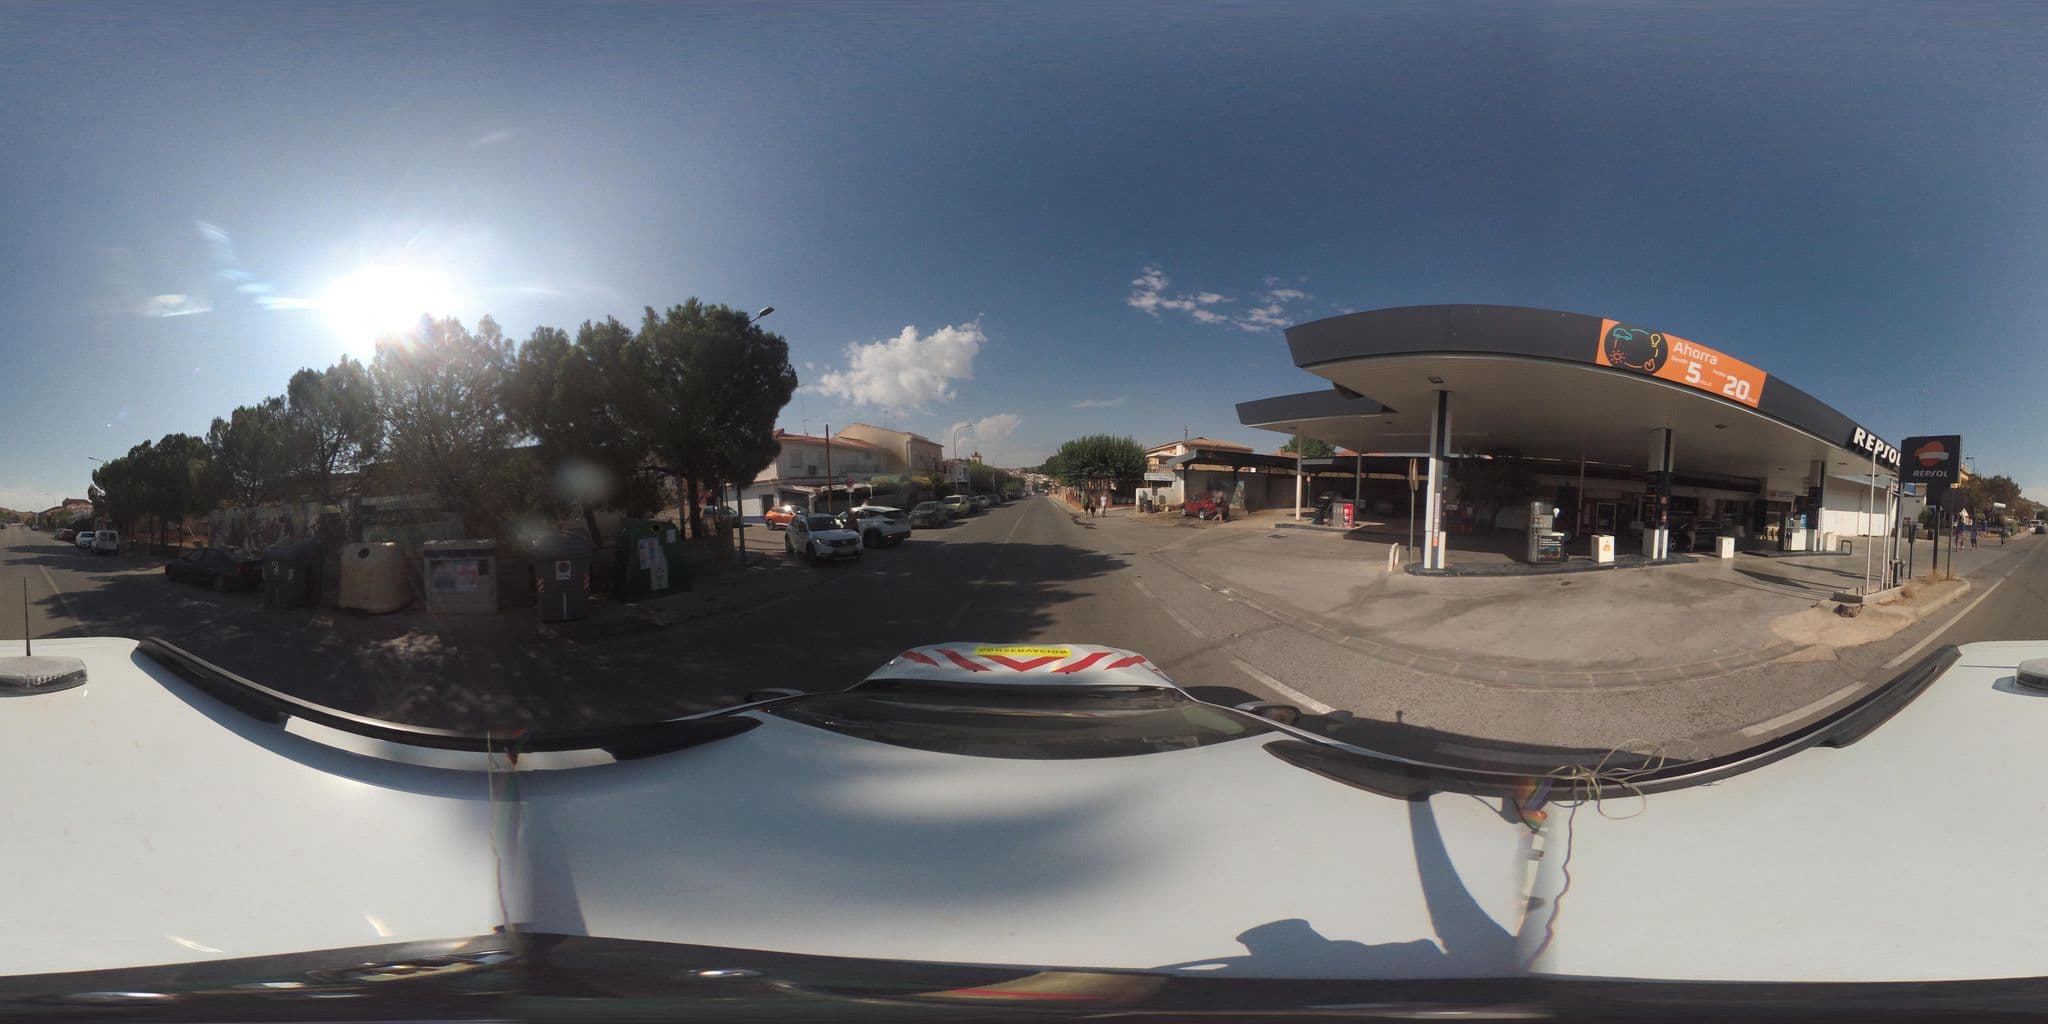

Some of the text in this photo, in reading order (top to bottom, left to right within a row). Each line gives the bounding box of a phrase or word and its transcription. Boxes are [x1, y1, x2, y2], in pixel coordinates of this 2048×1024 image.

[1673, 341, 1718, 365] Ahorra
[1684, 361, 1702, 384] 5
[1722, 375, 1750, 401] 20
[1853, 426, 1901, 466] REPSOL
[1912, 470, 1948, 478] REPSOL
